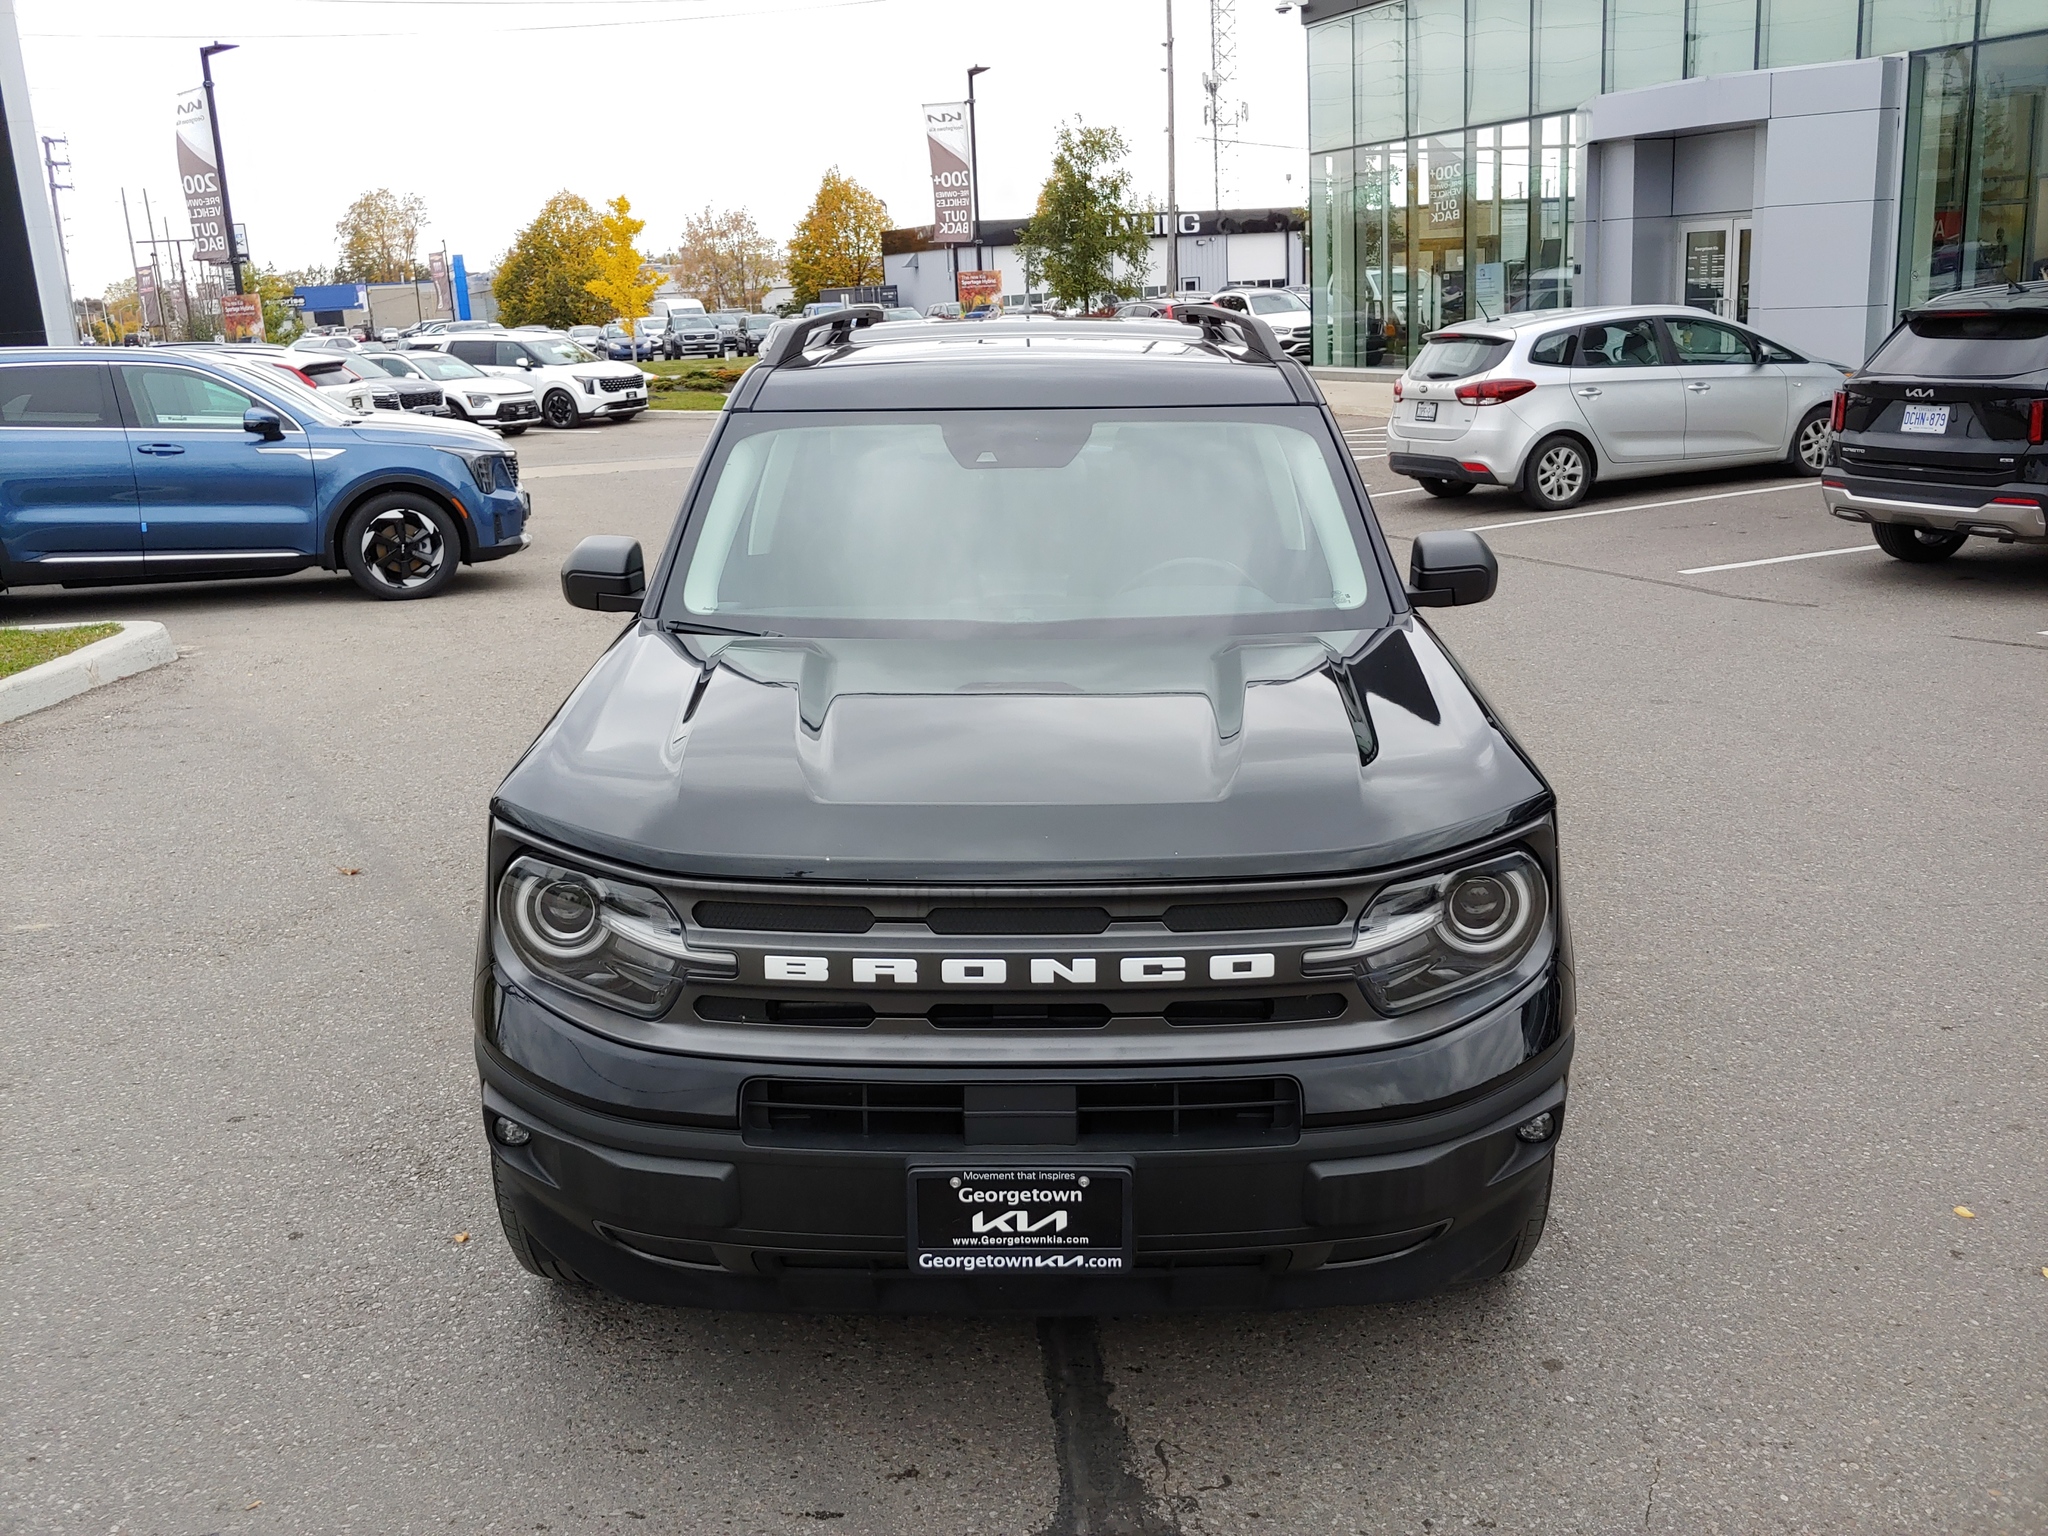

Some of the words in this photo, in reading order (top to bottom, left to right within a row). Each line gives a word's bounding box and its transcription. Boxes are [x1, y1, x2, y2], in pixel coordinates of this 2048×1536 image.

[764, 953, 1275, 984] BRONCO
[963, 1171, 1014, 1180] Movement
[1017, 1171, 1036, 1180] that
[1039, 1171, 1075, 1181] inspires
[958, 1188, 1082, 1205] Georgetown
[952, 1235, 1089, 1245] www.Georgetownkia.com
